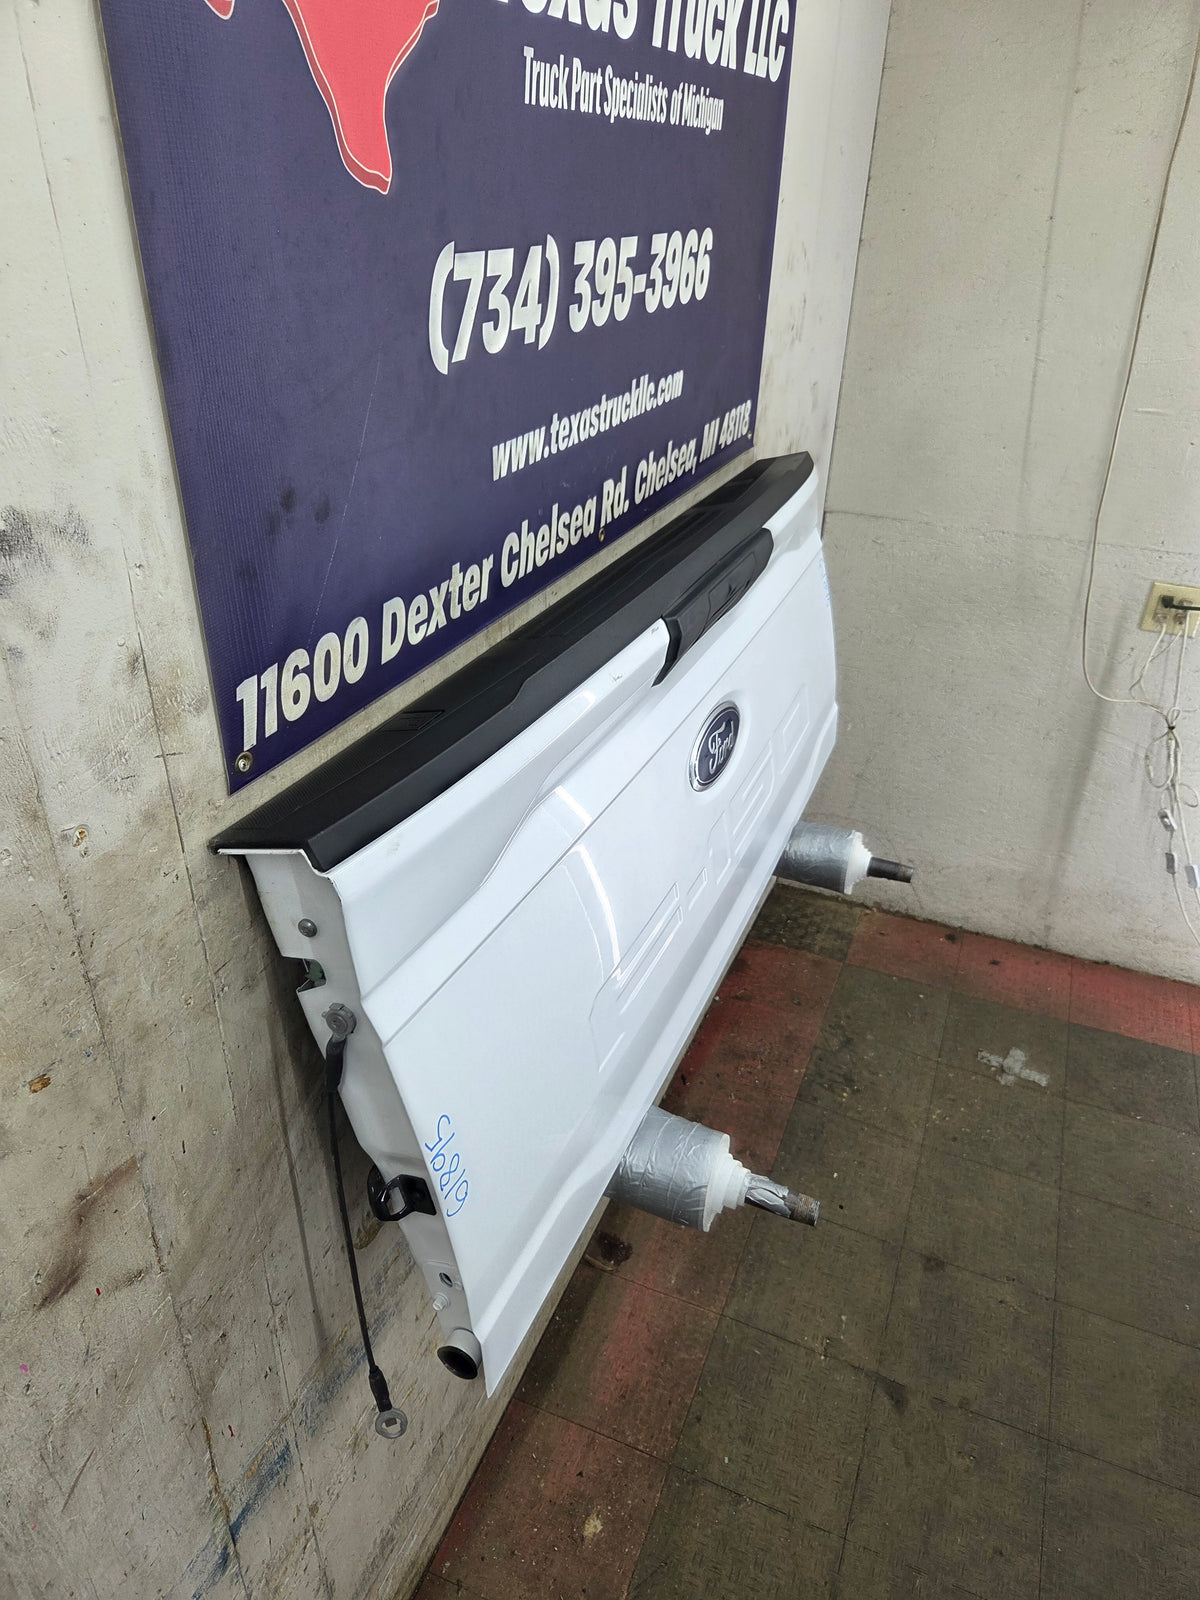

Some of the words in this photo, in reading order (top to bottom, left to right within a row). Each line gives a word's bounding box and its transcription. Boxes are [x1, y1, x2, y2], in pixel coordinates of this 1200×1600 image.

[523, 46, 570, 110] Truck
[570, 57, 603, 115] Part
[603, 64, 668, 124] Specialists
[669, 82, 684, 126] of
[681, 83, 724, 136] Michigan
[743, 0, 790, 83] LLC
[428, 233, 560, 375] (734)
[568, 227, 713, 333] 395-3966
[491, 369, 684, 482] www.texastruckllc.com
[235, 615, 370, 753] 11600
[381, 553, 495, 665] Dexter
[500, 497, 597, 589] Chelsea
[600, 465, 630, 529] Rd.
[634, 440, 698, 505] Chelsea,
[699, 417, 721, 463] MI
[718, 399, 752, 450] 48118
[708, 720, 736, 775] Ford
[424, 1114, 469, 1218] 61895
